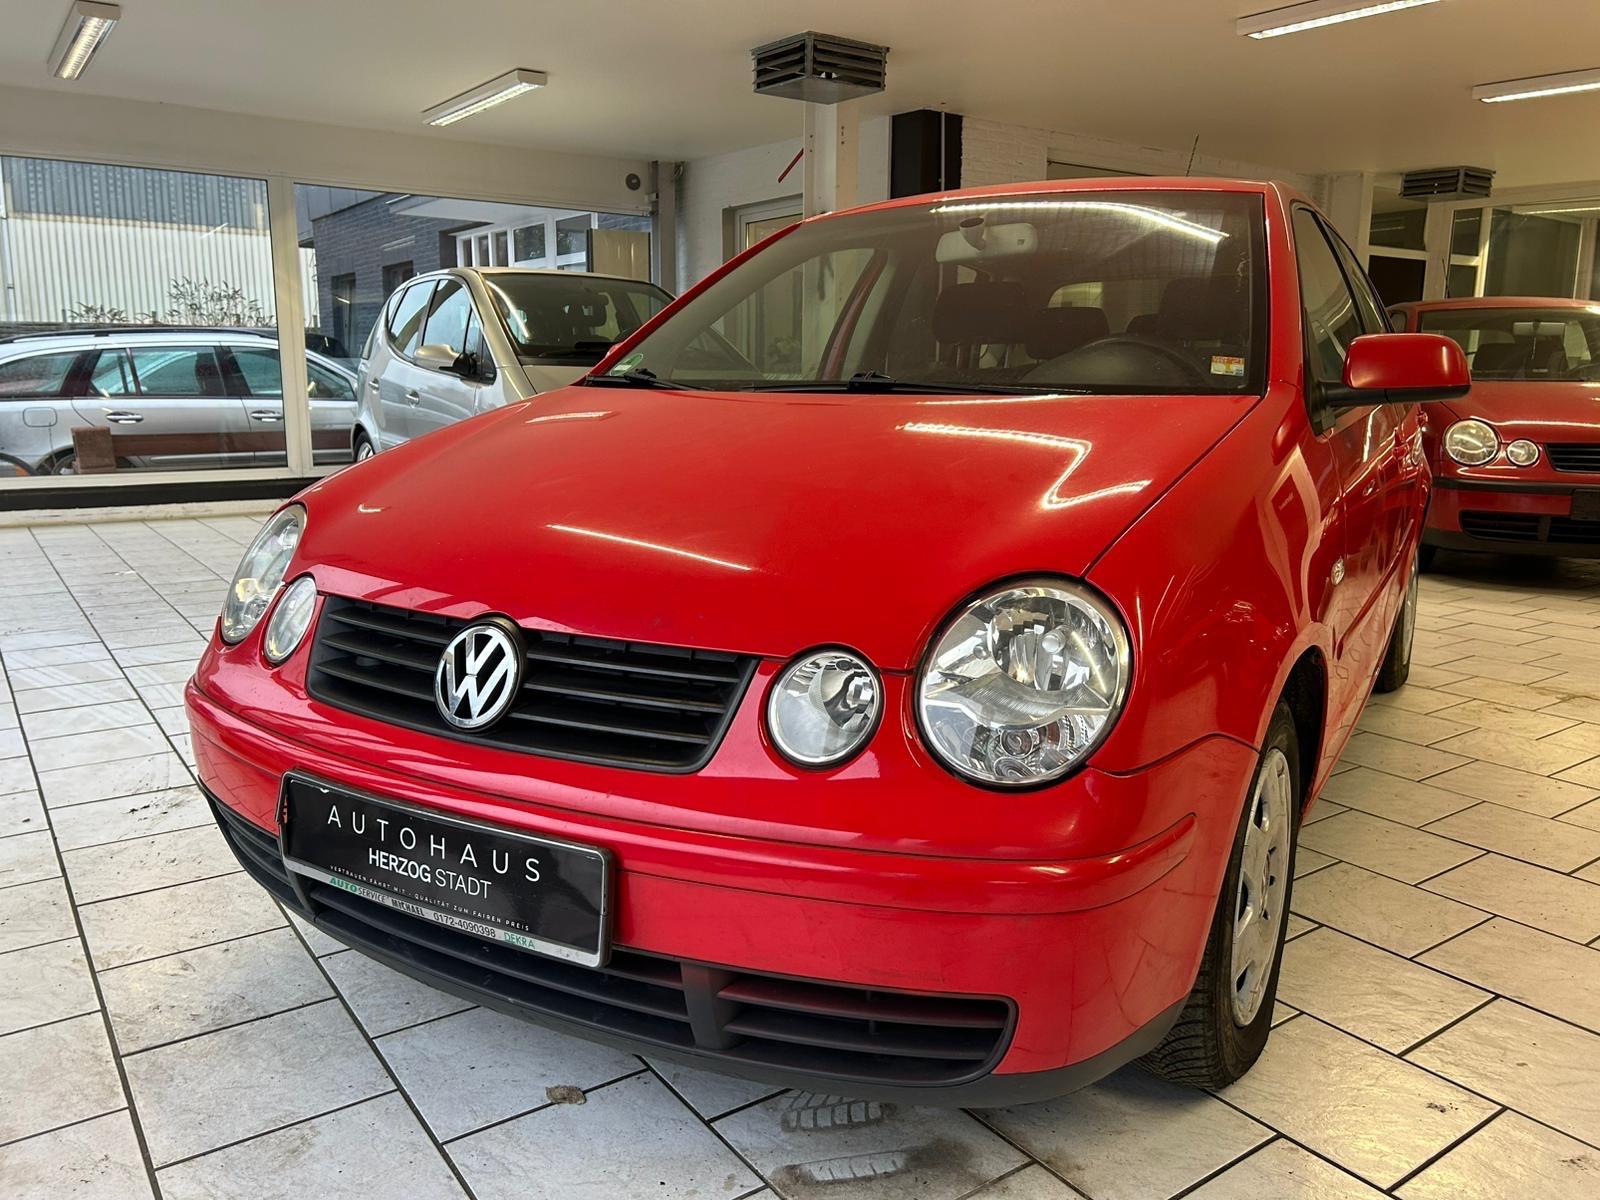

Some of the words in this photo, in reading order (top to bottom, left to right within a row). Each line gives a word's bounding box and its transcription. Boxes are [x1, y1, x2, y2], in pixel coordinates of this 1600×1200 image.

[437, 626, 516, 728] VW
[327, 805, 541, 882] AUTOHAUS
[368, 847, 431, 883] HERZOG
[435, 868, 492, 899] STADT
[391, 898, 425, 917] MICHAEL
[433, 912, 496, 938] 0172-4090398
[503, 931, 536, 949] DEKRA
[453, 904, 469, 914] ZUM
[472, 910, 501, 923] FAIREN
[505, 919, 530, 931] PREIS
